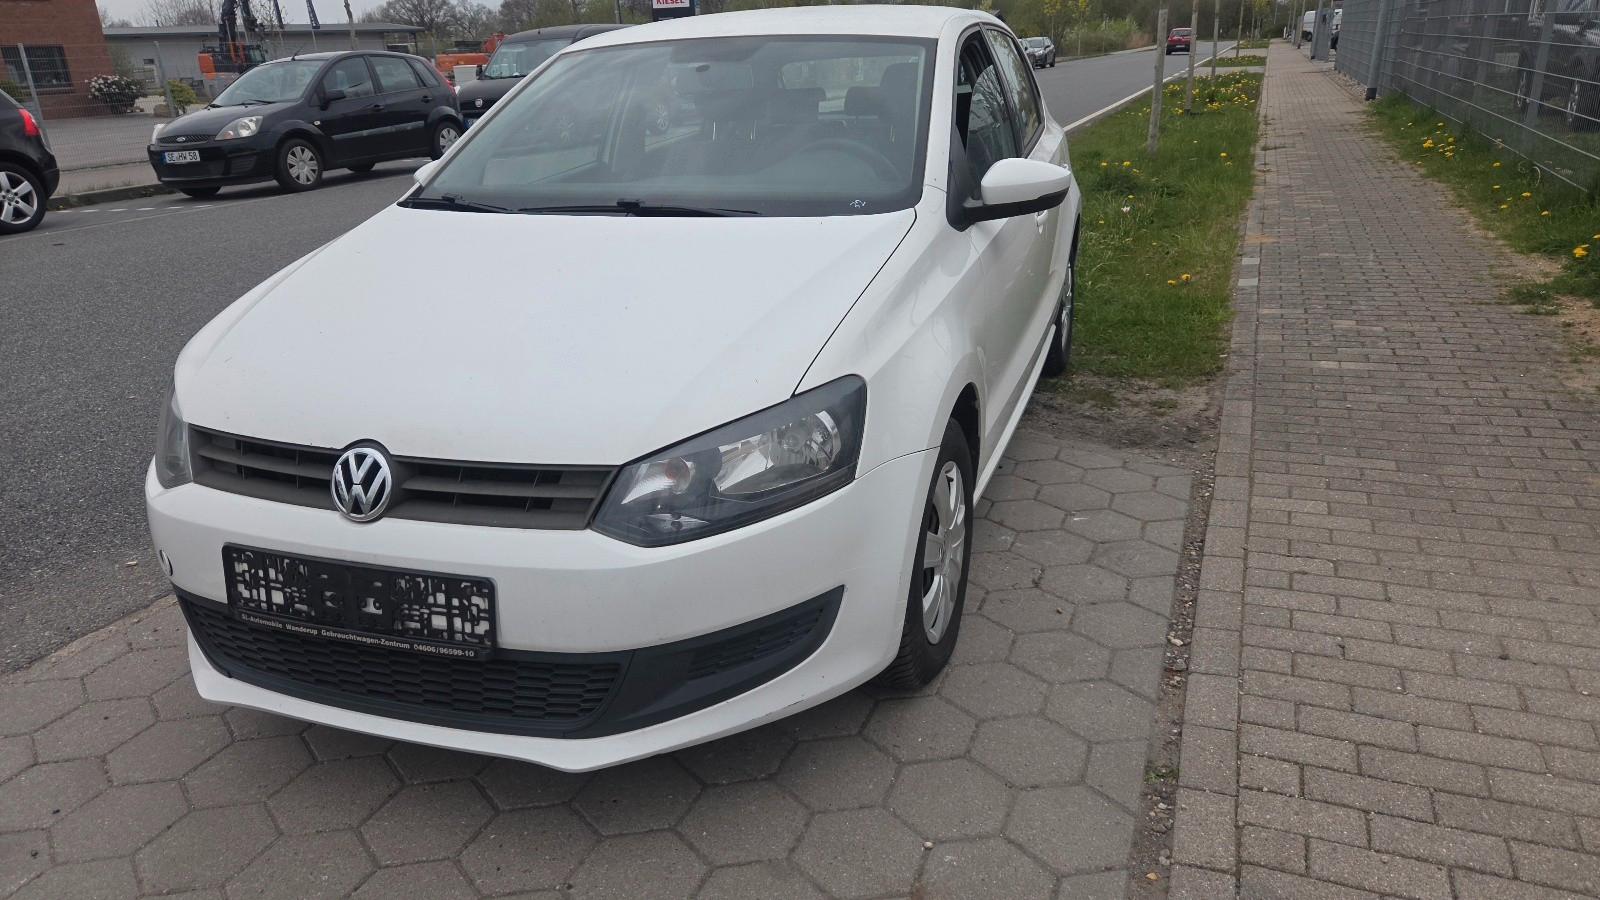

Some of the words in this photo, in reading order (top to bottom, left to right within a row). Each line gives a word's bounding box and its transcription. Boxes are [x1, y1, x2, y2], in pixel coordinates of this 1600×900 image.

[167, 152, 176, 161] SE
[189, 151, 198, 161] 58
[333, 449, 390, 518] VW
[285, 623, 318, 635] Wanderup
